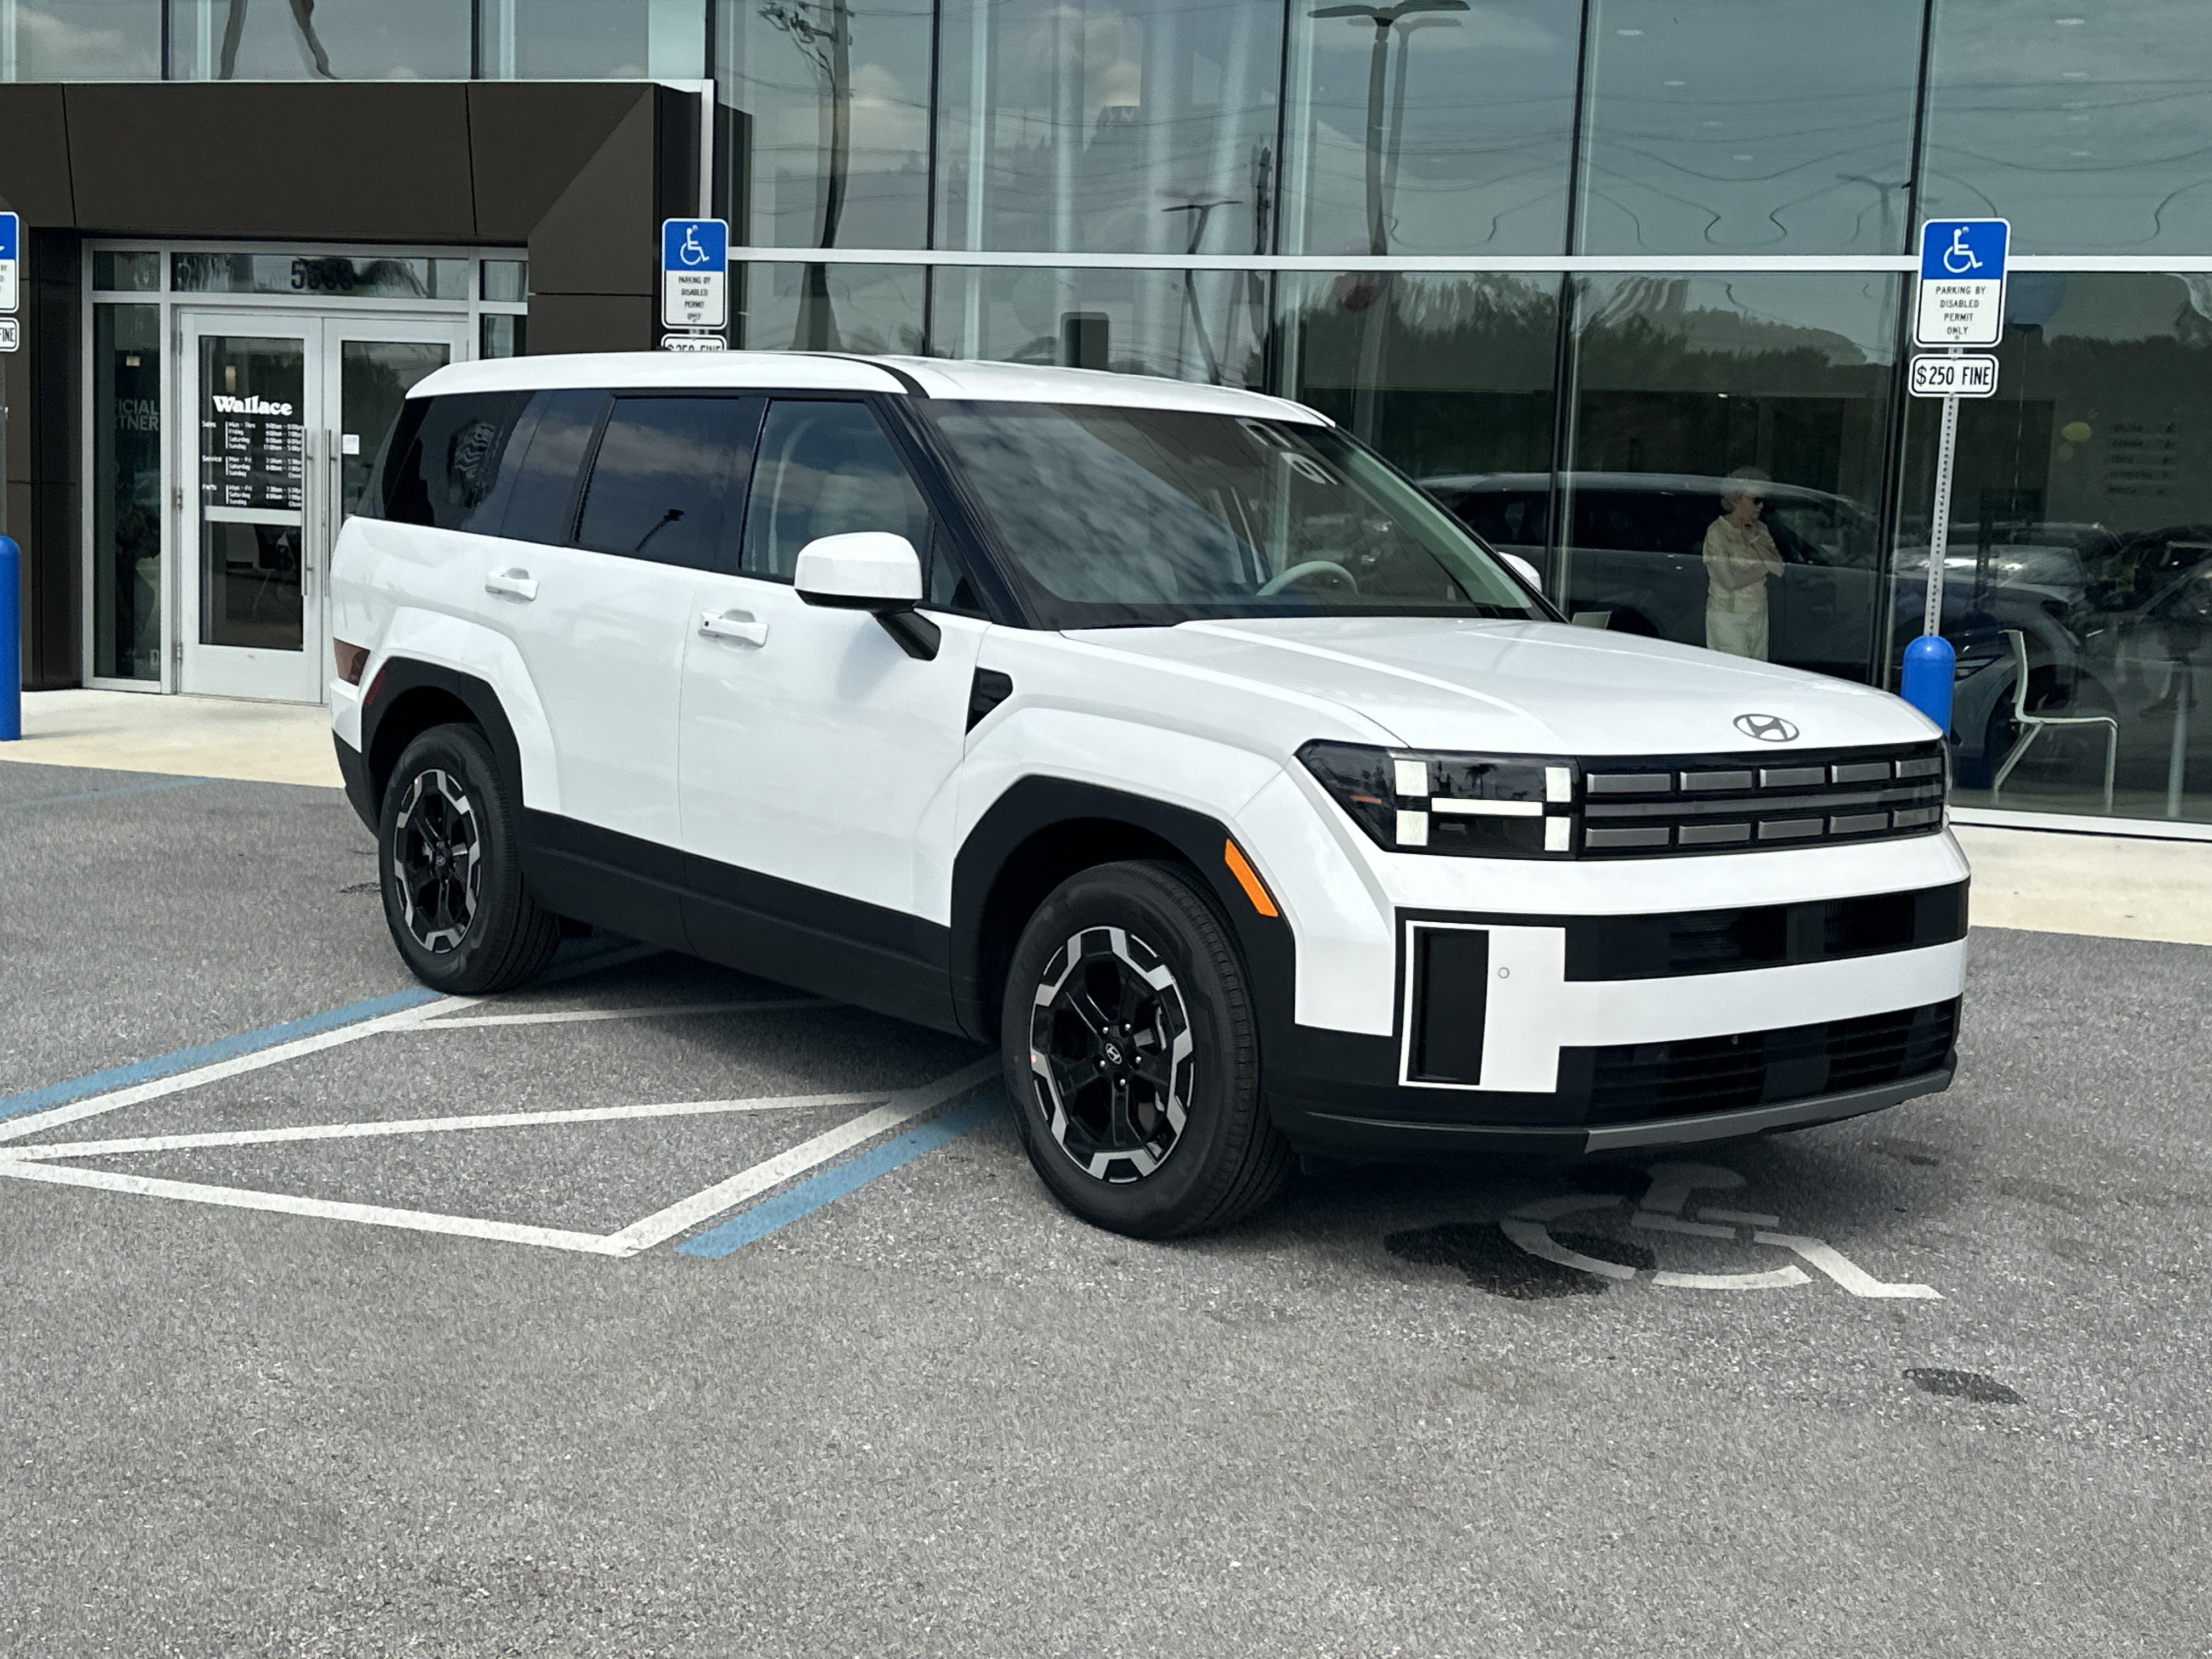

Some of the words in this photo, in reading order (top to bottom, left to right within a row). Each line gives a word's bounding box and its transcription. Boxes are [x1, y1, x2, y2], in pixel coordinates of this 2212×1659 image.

[1935, 286, 1972, 295] PARKING
[1976, 286, 1986, 295] BY
[1940, 299, 1979, 308] DISABLED
[1944, 313, 1974, 321] PERMIT
[1947, 326, 1968, 335] ONLY
[1916, 364, 1955, 387] $250
[1962, 366, 1991, 386] FINE
[212, 394, 293, 416] Wallace
